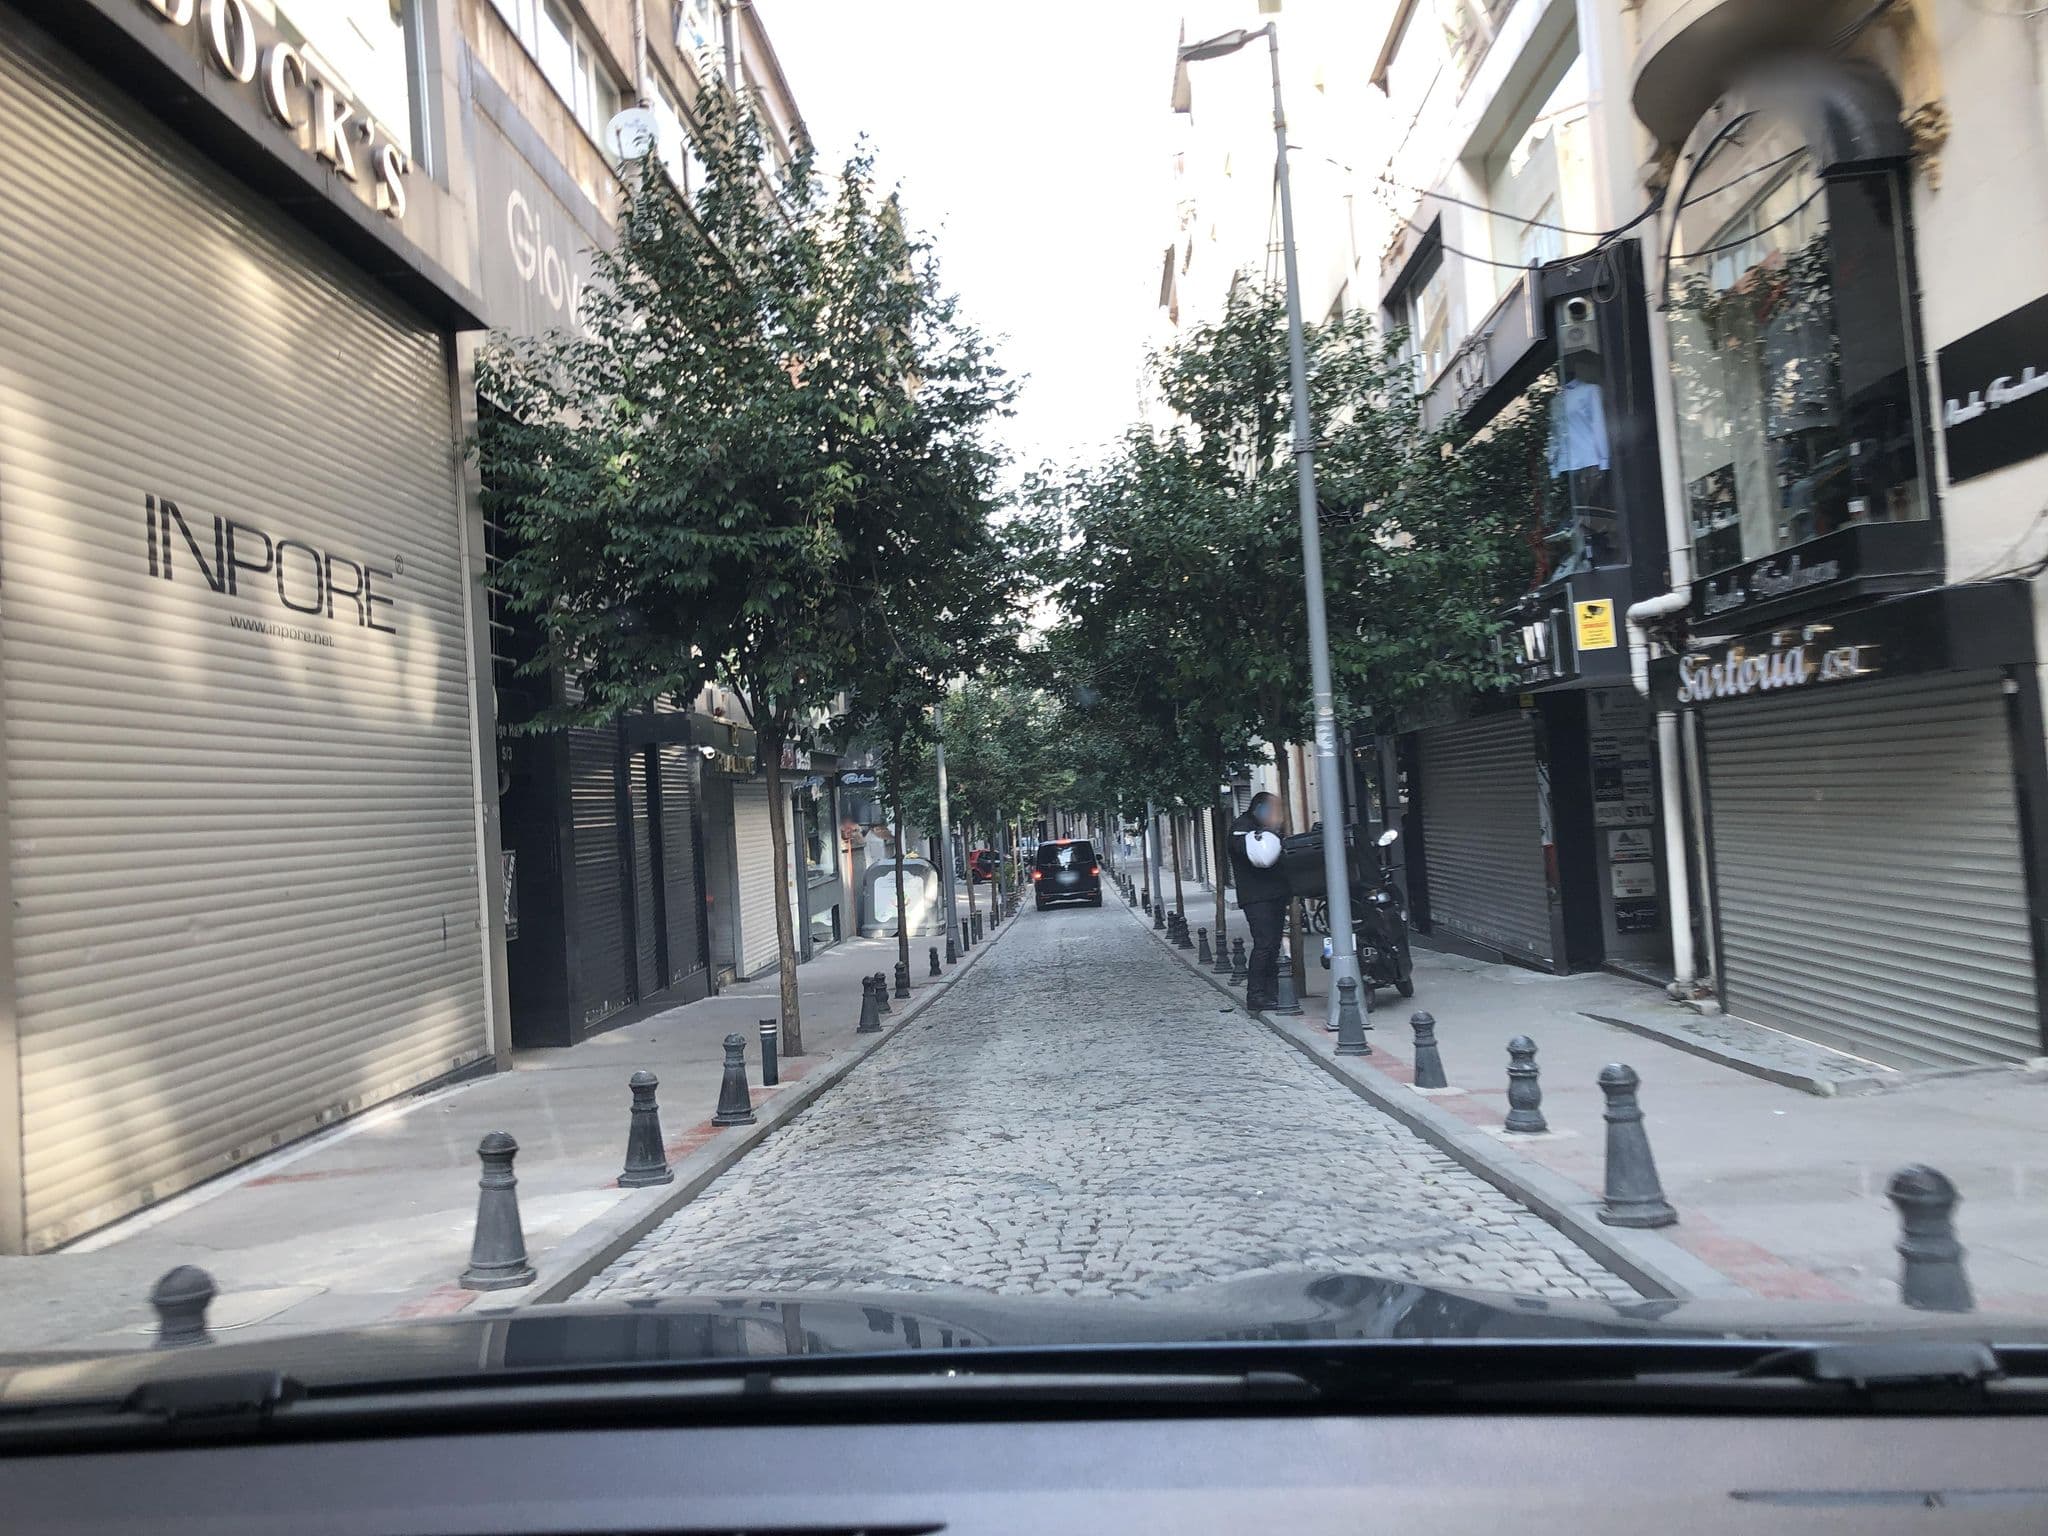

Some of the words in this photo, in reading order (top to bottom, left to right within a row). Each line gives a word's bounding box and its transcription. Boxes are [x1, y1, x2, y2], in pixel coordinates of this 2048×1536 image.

[148, 0, 412, 219] OCK'S
[145, 493, 397, 635] INPORE
[230, 615, 335, 648] www.inpore.net
